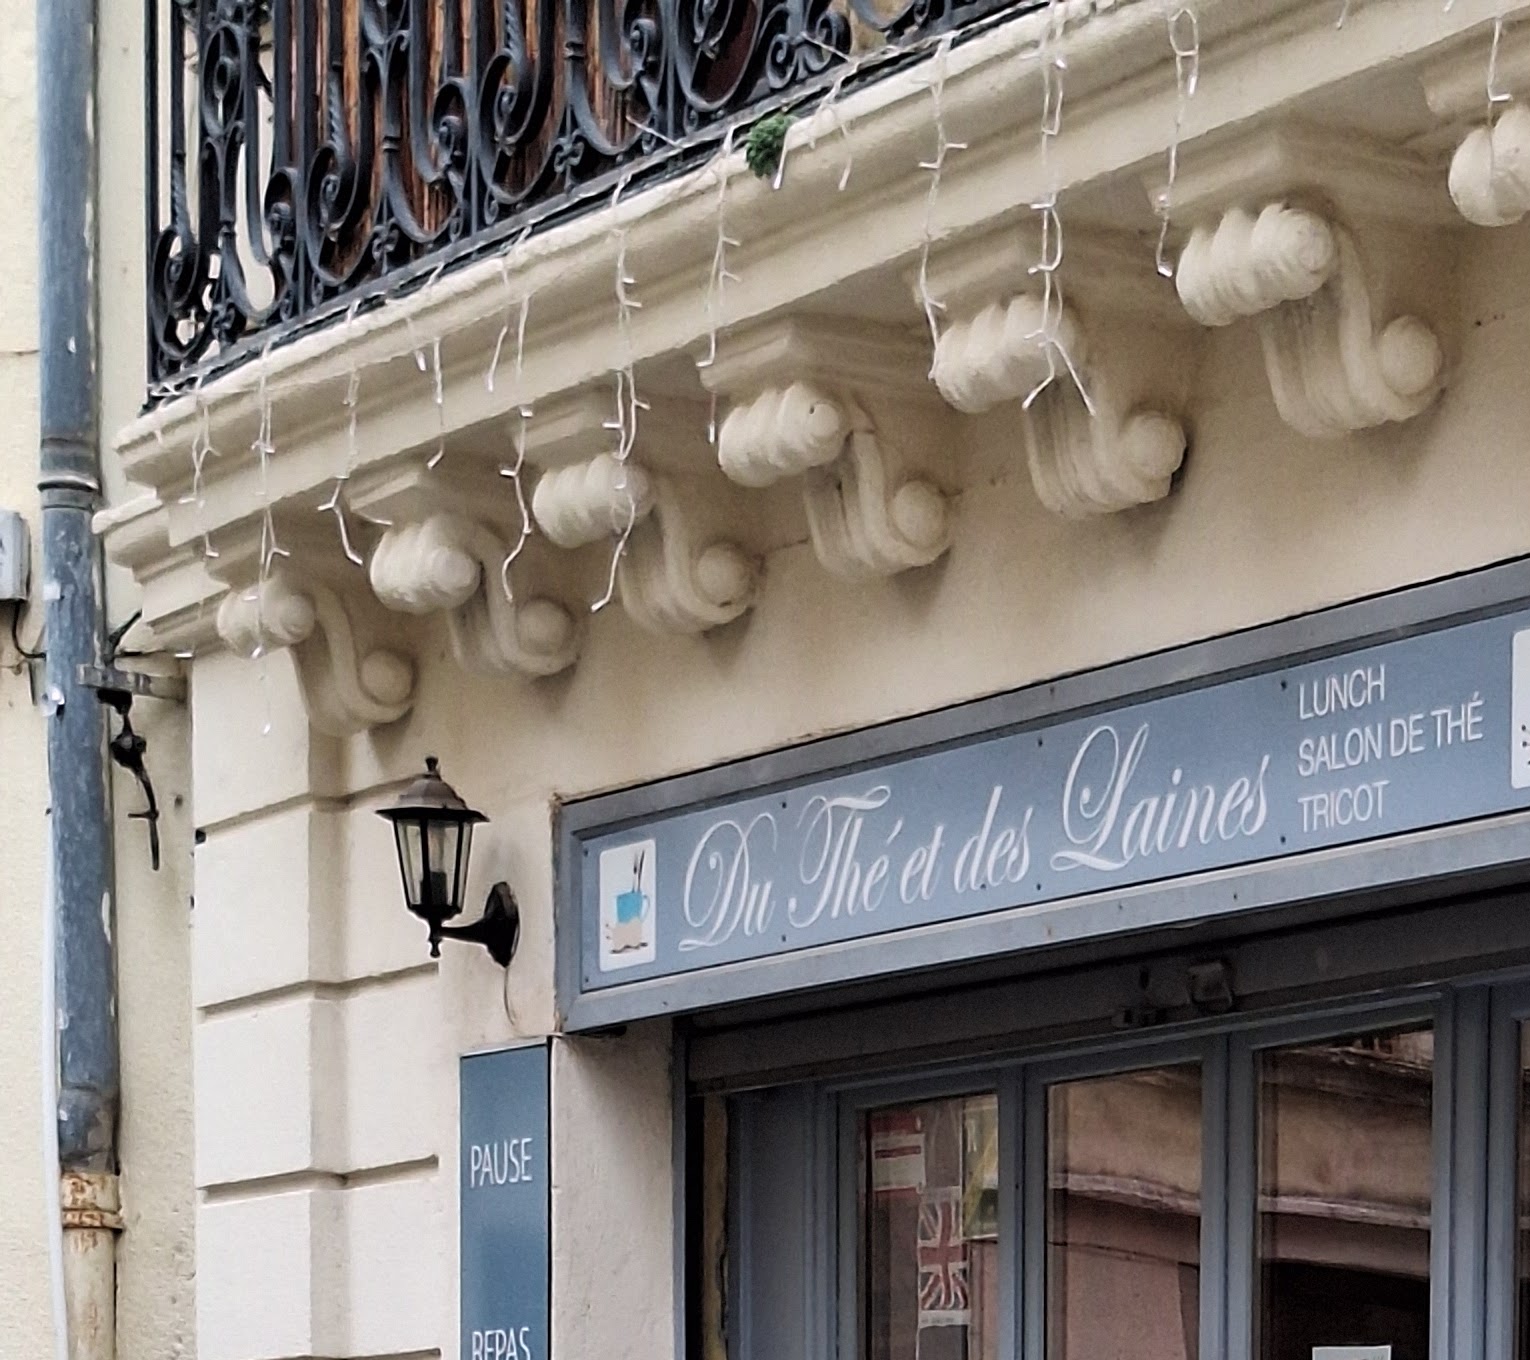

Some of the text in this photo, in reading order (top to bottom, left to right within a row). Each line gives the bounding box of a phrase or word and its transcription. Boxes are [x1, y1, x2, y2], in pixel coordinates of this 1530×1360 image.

[1299, 663, 1385, 720] LUNCH
[1298, 690, 1485, 777] SALON DE THÉ
[1297, 779, 1390, 833] TRICOT
[679, 722, 1270, 951] Du Thé et des Laines
[470, 1137, 534, 1189] PAUSE
